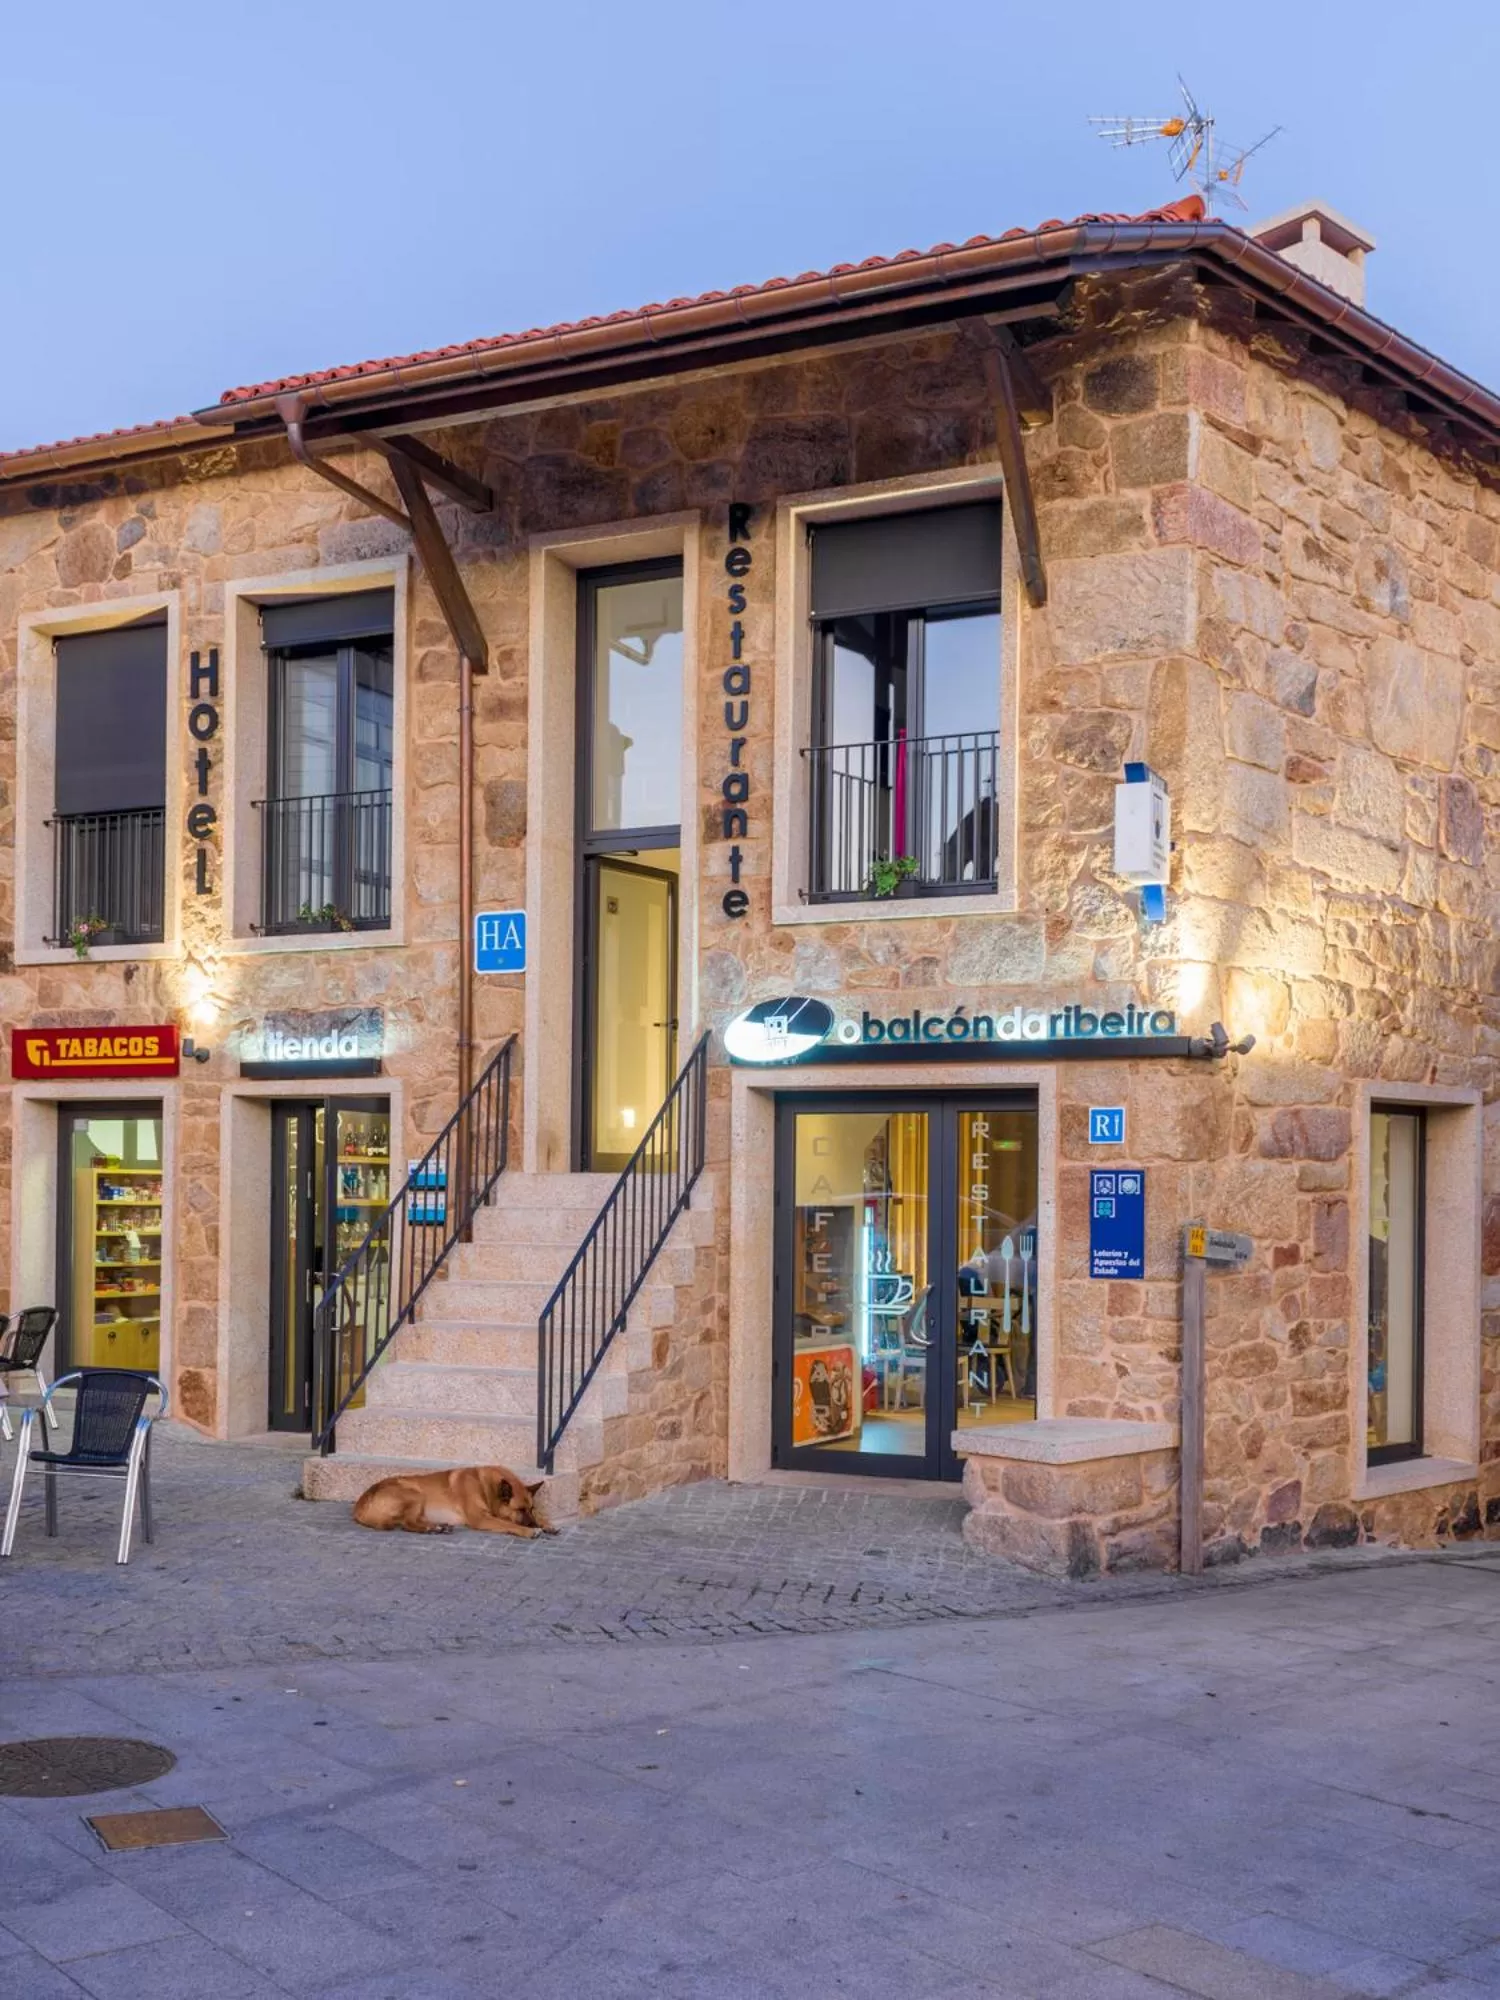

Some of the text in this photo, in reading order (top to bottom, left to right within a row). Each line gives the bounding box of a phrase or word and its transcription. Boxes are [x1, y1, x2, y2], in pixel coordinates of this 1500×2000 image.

[188, 648, 219, 895] Hotel
[722, 503, 752, 918] Restaurante
[480, 918, 522, 951] HA
[56, 1036, 159, 1058] TABACOS
[265, 1029, 359, 1061] tienda
[969, 1121, 990, 1419] RESTAURANT
